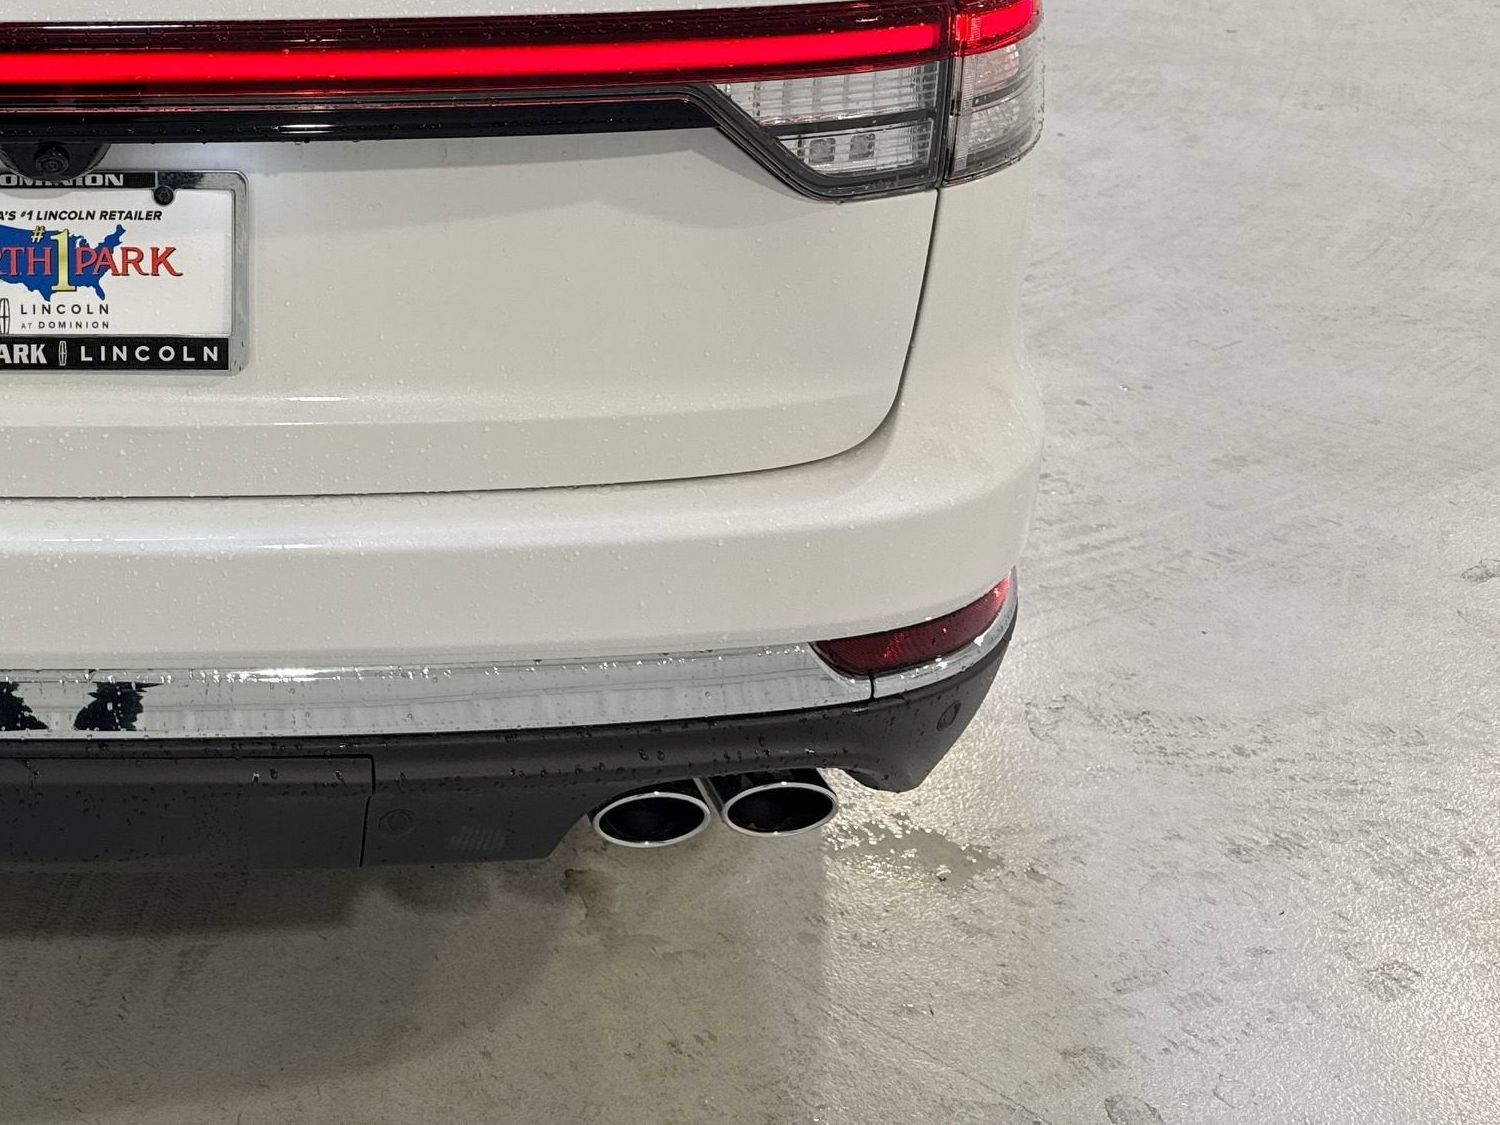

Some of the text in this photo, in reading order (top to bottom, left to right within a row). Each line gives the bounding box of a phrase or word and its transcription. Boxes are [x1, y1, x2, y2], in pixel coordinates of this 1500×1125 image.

[20, 210, 34, 221] #1
[36, 210, 96, 221] LINCOLN
[99, 210, 162, 221] RETAILER
[75, 246, 184, 277] PARK
[20, 303, 110, 316] LINCOLN
[20, 321, 110, 330] AT DOMINION
[80, 345, 219, 362] LINCOLN
